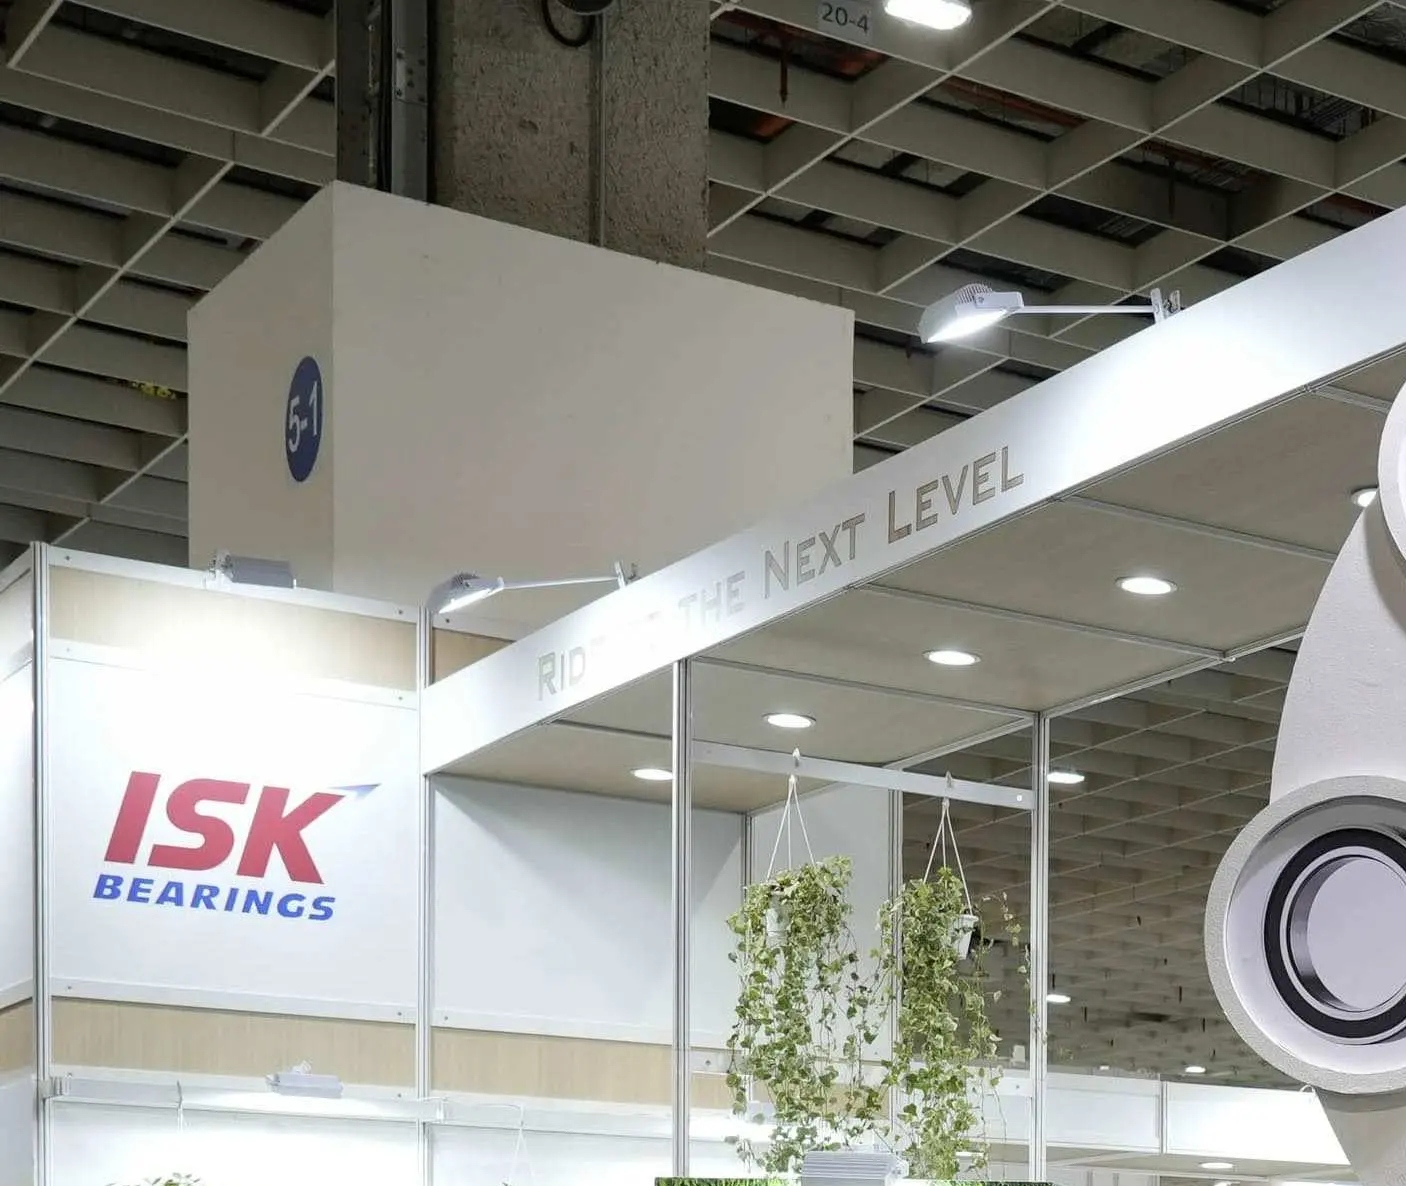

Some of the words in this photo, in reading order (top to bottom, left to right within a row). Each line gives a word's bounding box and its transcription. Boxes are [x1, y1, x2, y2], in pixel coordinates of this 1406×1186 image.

[822, 3, 868, 33] 20-4
[288, 381, 318, 452] 5-1
[538, 634, 607, 701] RID
[764, 513, 865, 599] NEXT
[888, 446, 1024, 544] LEVEL
[104, 771, 346, 884] ISK
[92, 874, 337, 921] BEARINGS
